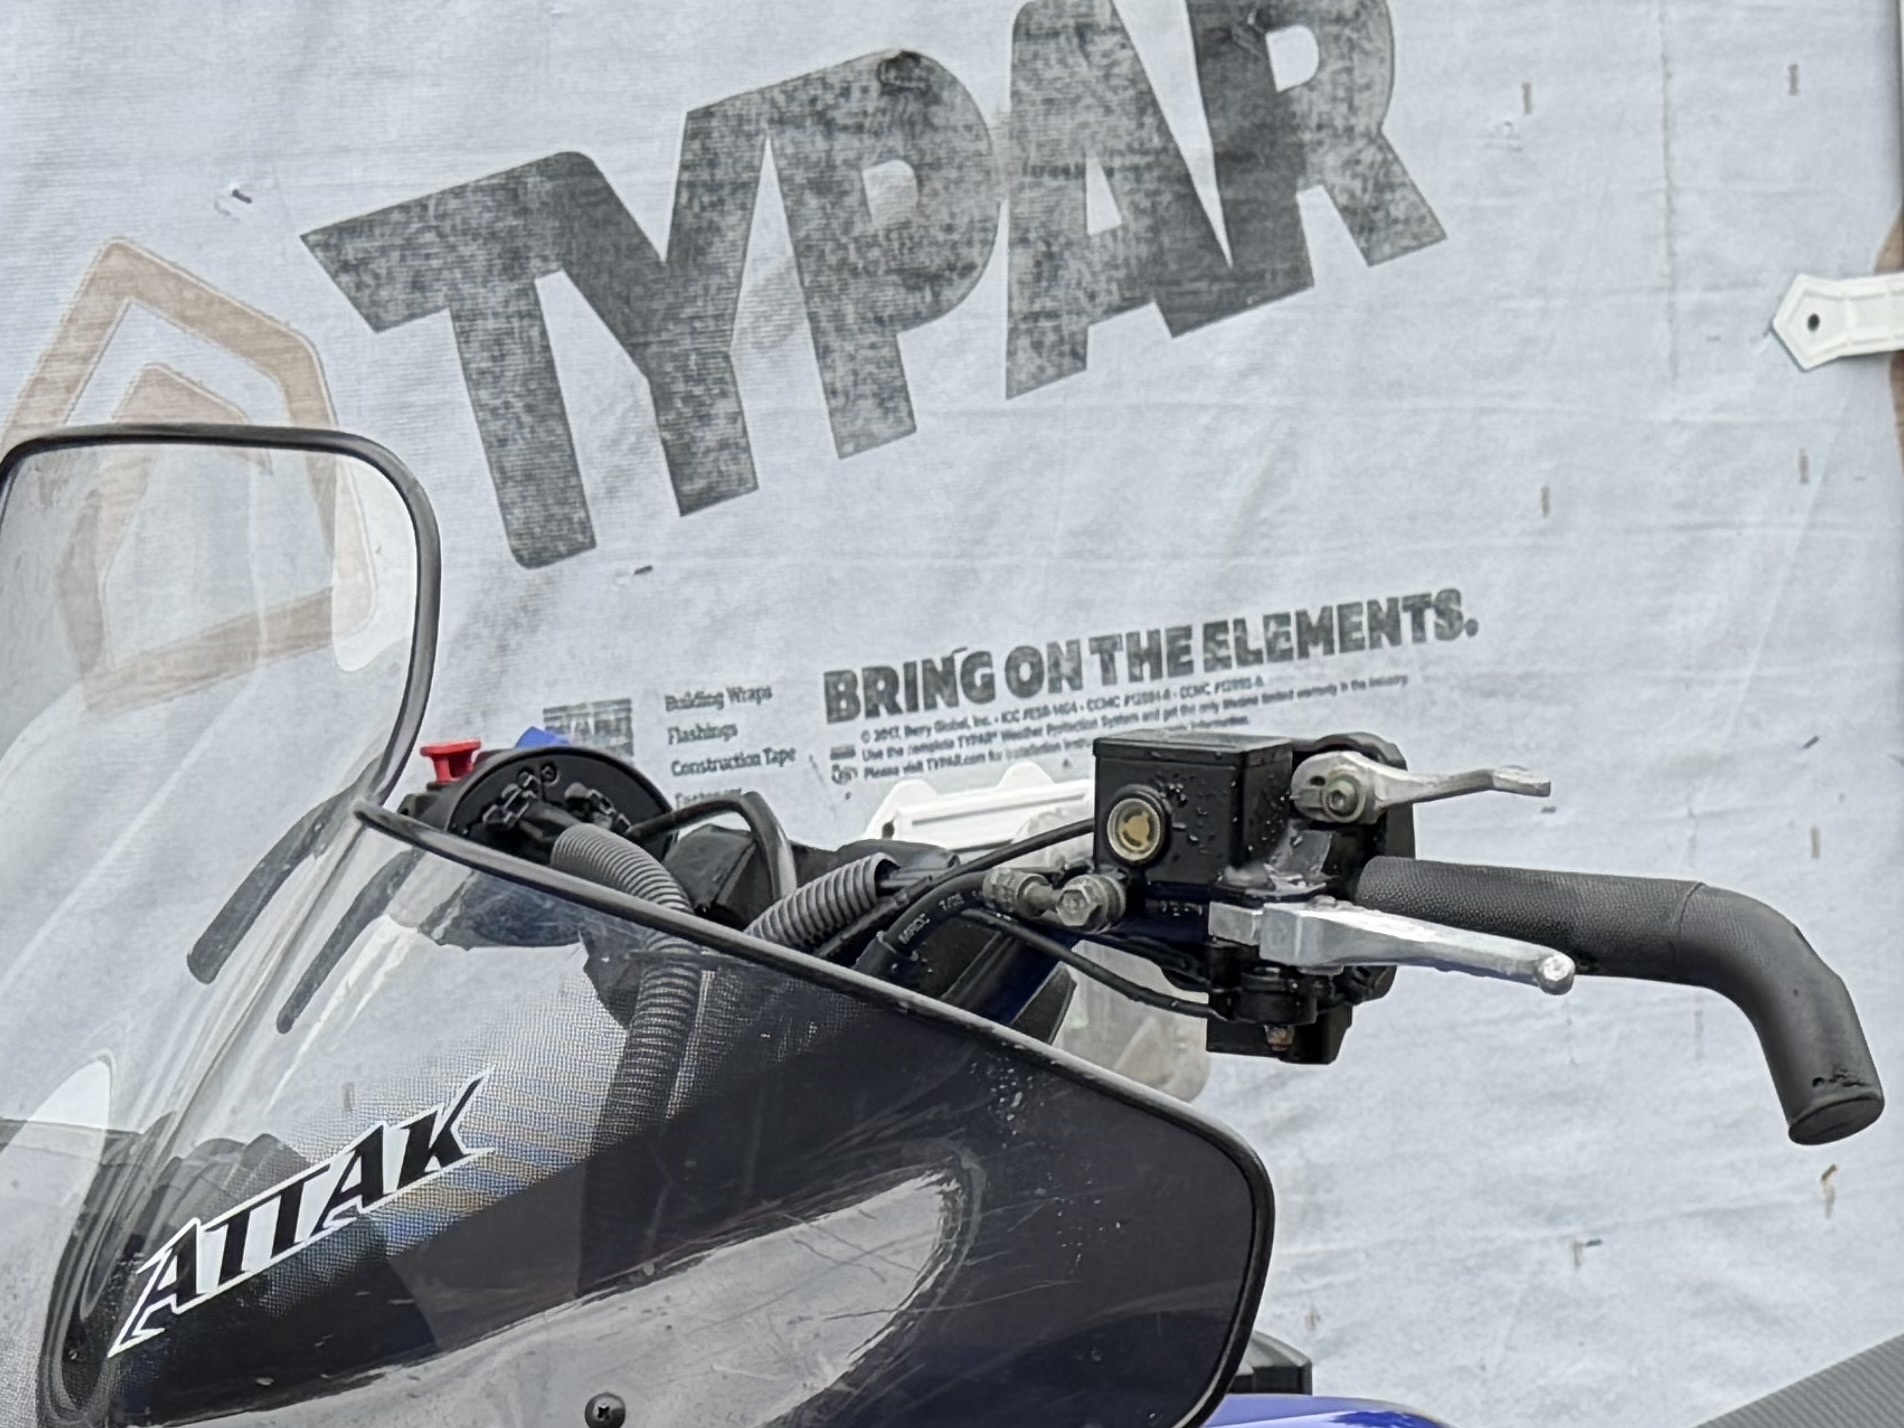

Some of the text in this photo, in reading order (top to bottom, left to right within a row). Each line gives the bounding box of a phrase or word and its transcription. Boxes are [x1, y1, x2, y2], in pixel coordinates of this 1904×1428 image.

[300, 0, 1448, 570] TYPAR
[823, 588, 1479, 725] BRING ON THE ELEMENTS.
[665, 684, 773, 712] Building Wraps
[668, 722, 738, 745] Flashings
[904, 725, 931, 738] Berry
[671, 747, 796, 777] Construction Tape
[108, 1063, 496, 1358] ATTAK
